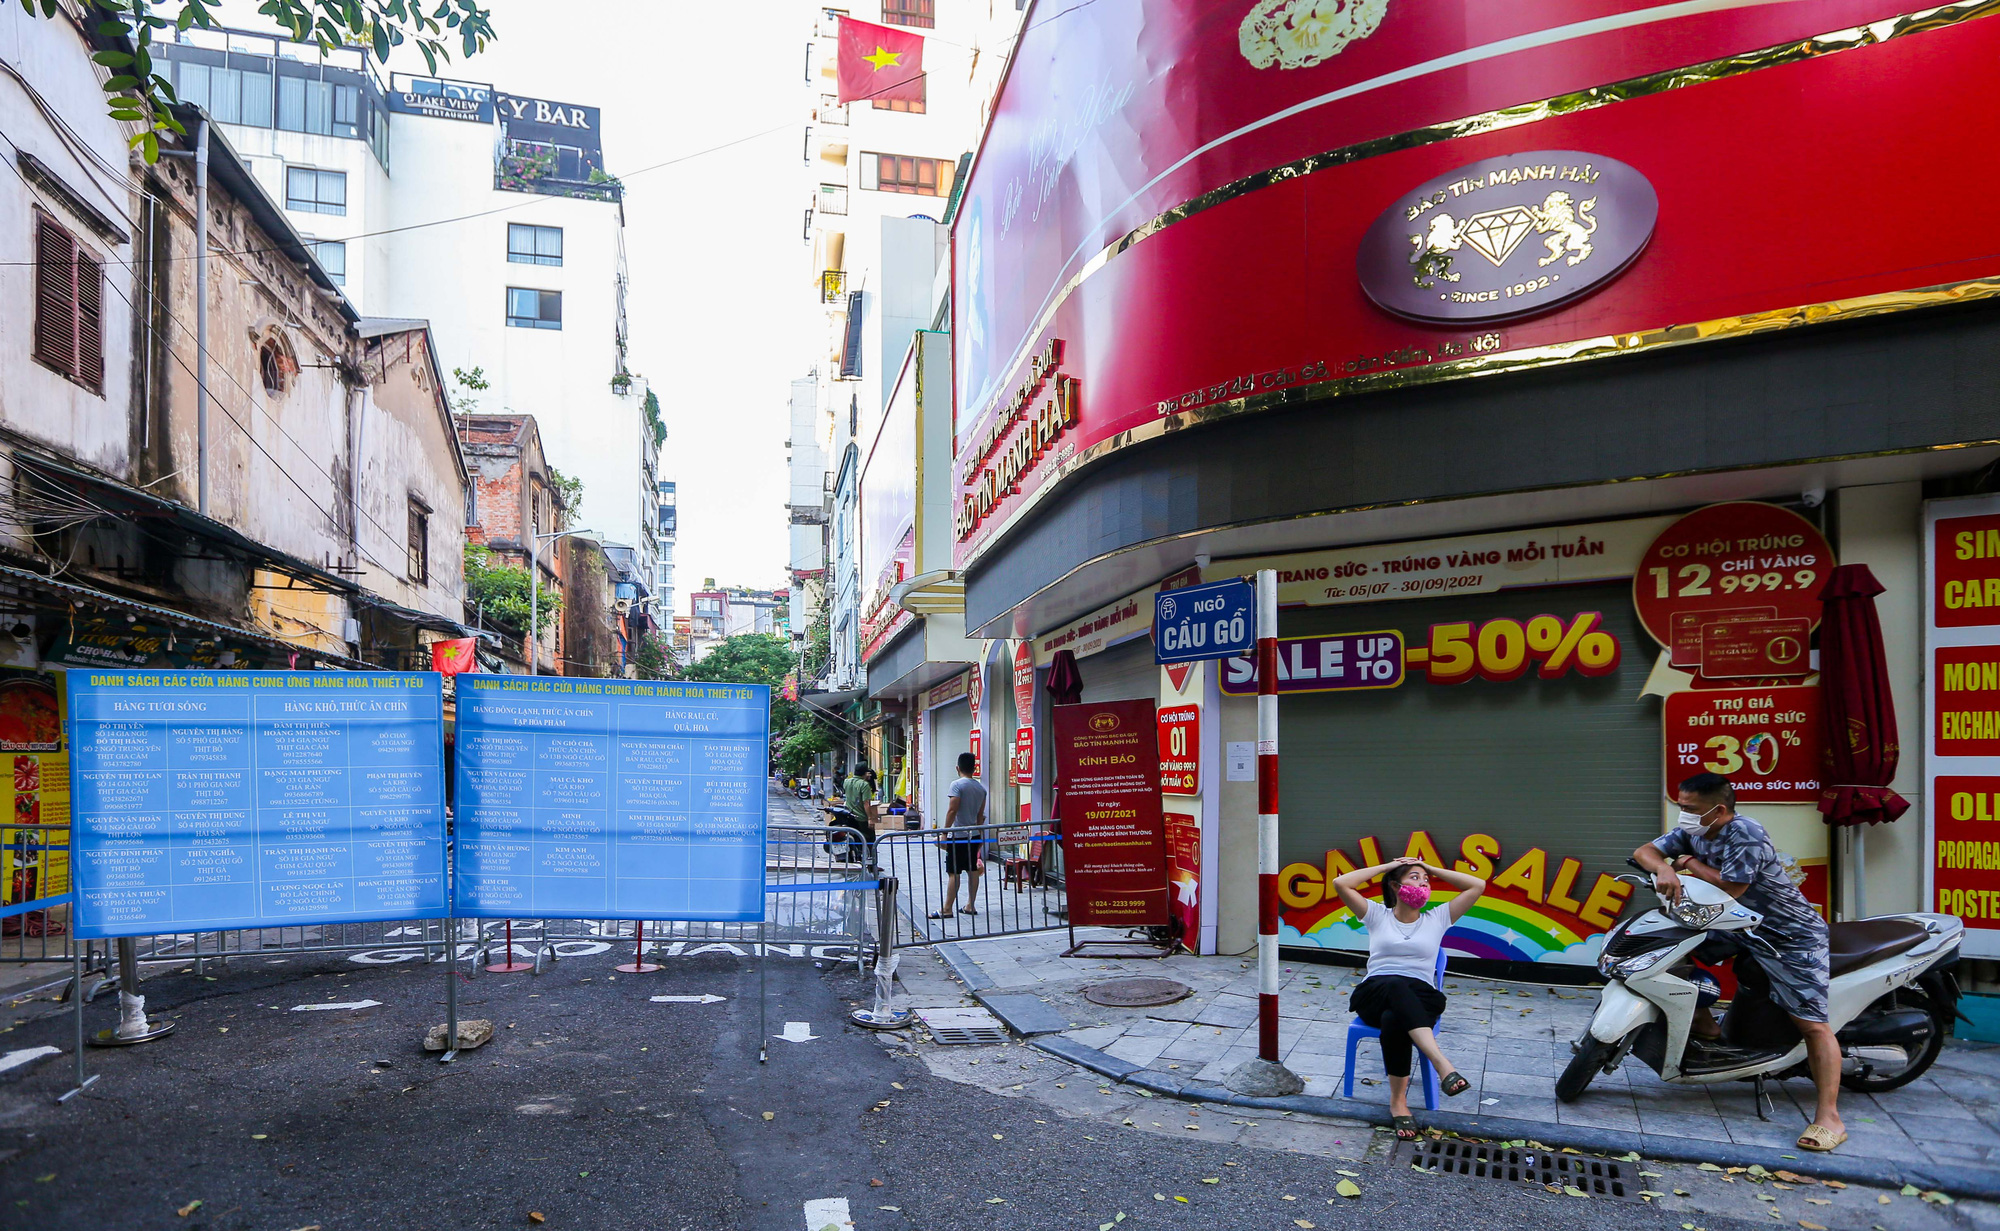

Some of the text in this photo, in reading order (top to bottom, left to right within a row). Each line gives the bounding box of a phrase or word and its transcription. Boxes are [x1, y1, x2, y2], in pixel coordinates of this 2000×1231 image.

[403, 93, 479, 110] O'LAKE VIEW
[422, 108, 480, 122] RESTAURANT
[534, 100, 590, 129] BAR
[1489, 165, 1557, 186] MẠNH
[1559, 163, 1600, 185] HẢI
[1451, 276, 1550, 304] SINCE 1992
[1157, 400, 1178, 416] Địa
[1208, 382, 1228, 400] Số
[1230, 372, 1256, 394] 44
[1438, 342, 1464, 358] Hà
[1468, 333, 1500, 352] Nội
[956, 492, 974, 542] BẢO
[977, 469, 994, 513] TÍN
[995, 419, 1033, 494] MẠNH
[1037, 372, 1070, 450] HẢI
[1659, 533, 1805, 560] CƠ HỘI TRÚNG
[1277, 536, 1604, 584] TRANG SỨC TRÚNG VÀNG MỖI TUẦN
[1721, 554, 1816, 572] CHỈ VÀNG
[1349, 582, 1390, 598] 05/07
[1400, 574, 1484, 595] 30/09/2021
[1649, 564, 1712, 599] 12
[1719, 570, 1816, 594] 999.9
[1194, 594, 1226, 614] NGÕ
[1164, 608, 1247, 650] CẦU GỖ
[76, 645, 100, 657] CHỢ
[1356, 638, 1394, 658] UP
[1406, 612, 1619, 683] -50%
[1776, 641, 1789, 659] 1
[1356, 660, 1394, 680] TO
[1944, 662, 2000, 692] MON
[91, 673, 423, 688] DANH SÁCH CÁC CỬA HÀNG CUNG ỨNG HÀNG HÓA THIẾT YẾU
[474, 679, 753, 699] DANH SÁCH CÁC CỬA HÀNG CUNG ỨNG HÀNG HÓA THIẾT YẾU
[114, 700, 207, 711] HÀNG TƯƠI SỐNG
[284, 700, 408, 712] HÀNG KHÔ, THỨC ĂN CHÍN
[473, 705, 496, 713] HÀNG
[576, 708, 594, 716] CHÍN
[1713, 695, 1774, 712] TRỢ GIÁ
[665, 710, 687, 719] HÀNG
[688, 712, 705, 720] RAU,
[1161, 710, 1195, 724] CƠ HỘI TRÚNG
[1688, 710, 1806, 726] ĐỔI TRANG SỨC
[693, 724, 709, 732] HOA
[1170, 726, 1186, 756] 01
[1678, 743, 1698, 753] UP
[1079, 754, 1136, 766] KÍNH BÁO
[1169, 760, 1183, 771] VÀNG
[1183, 762, 1196, 771] 999.9
[1678, 754, 1700, 764] TO
[1730, 780, 1820, 790] RANG SỨC MỚI
[1085, 810, 1136, 820] 19/07/2021
[1951, 792, 2000, 821] OL
[1455, 833, 1635, 930] SALE
